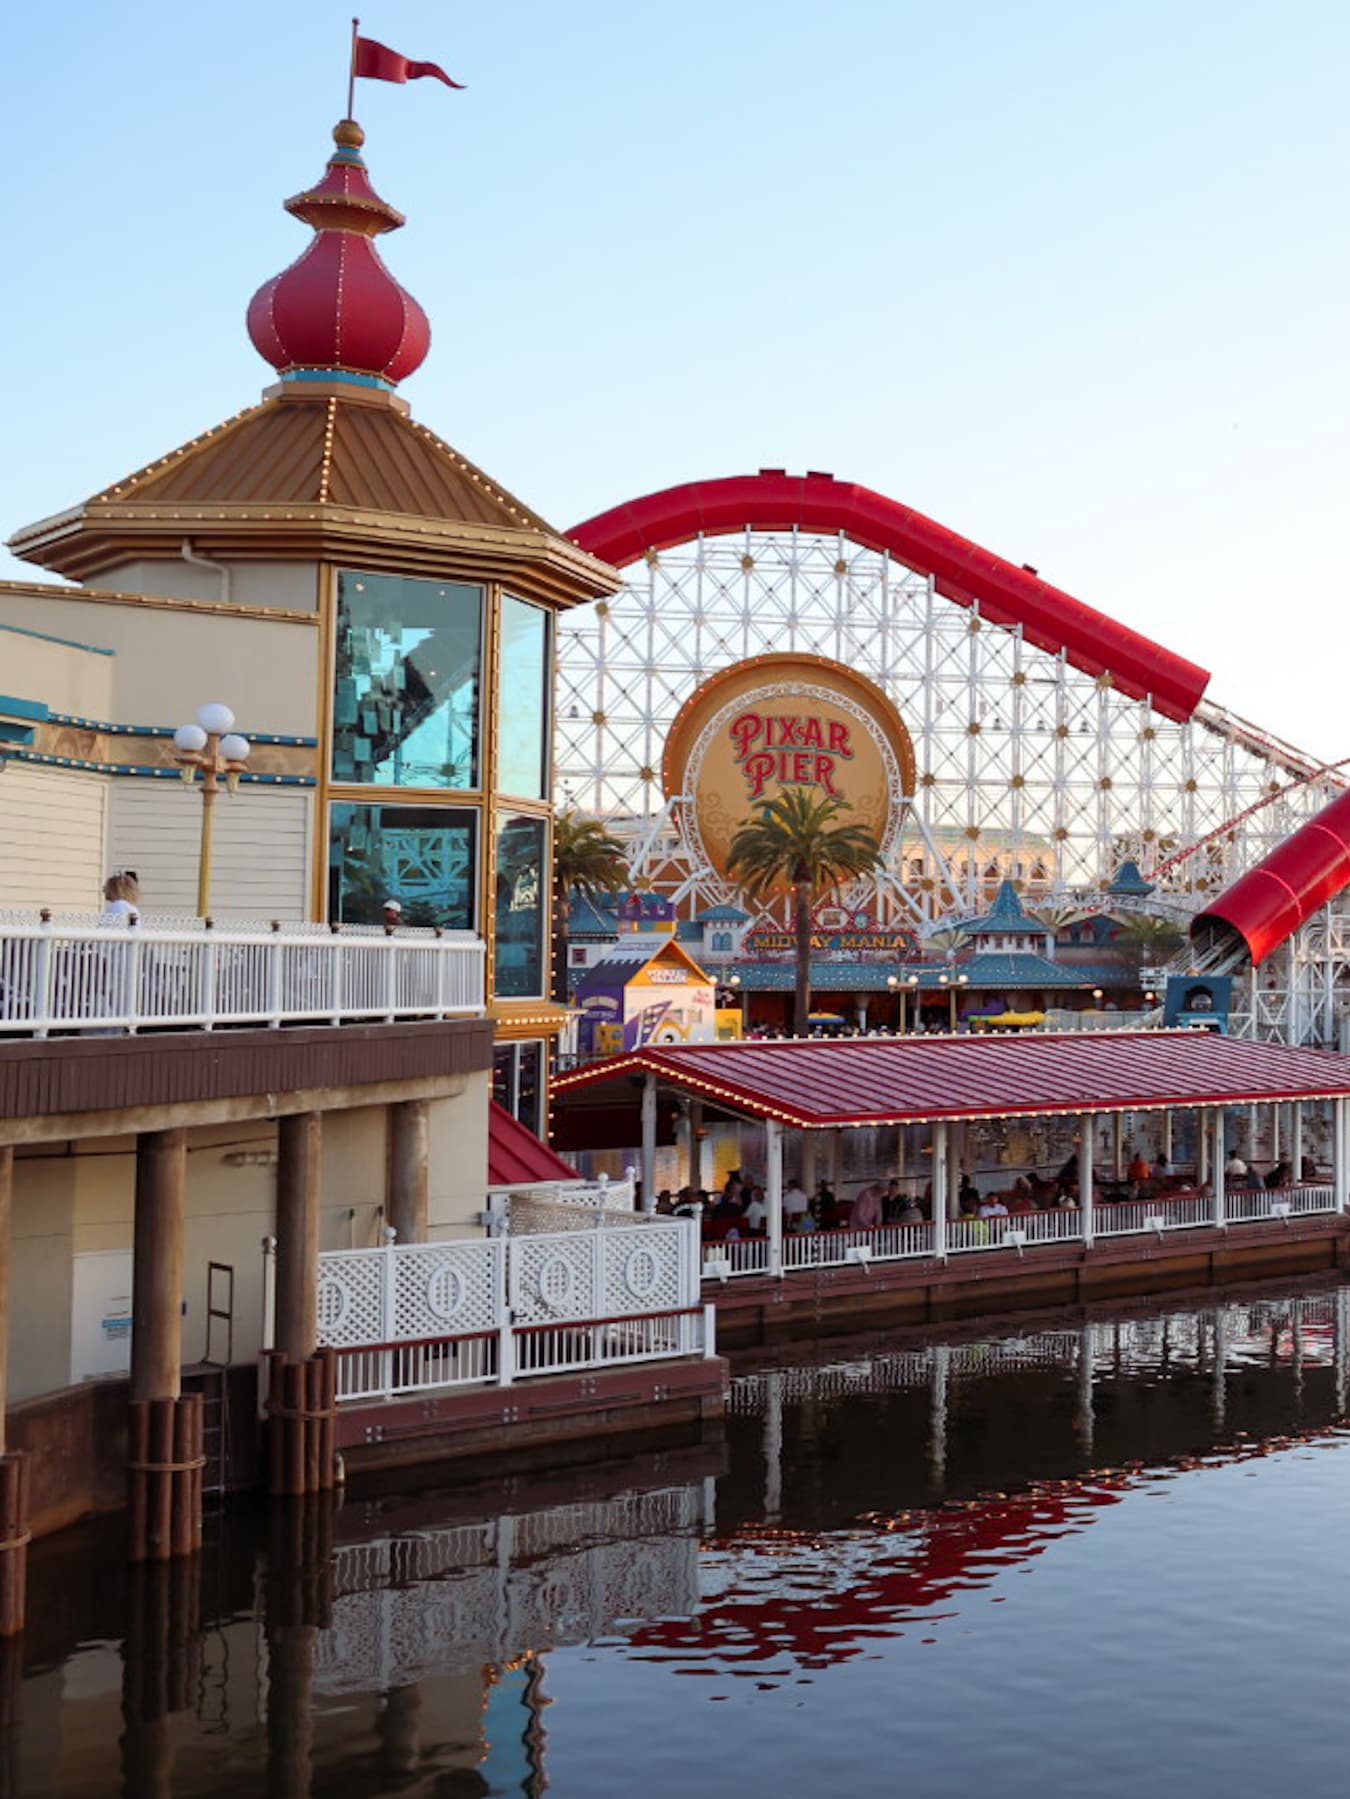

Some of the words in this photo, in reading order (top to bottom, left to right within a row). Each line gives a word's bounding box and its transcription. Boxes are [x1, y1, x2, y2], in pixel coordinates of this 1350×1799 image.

[730, 713, 854, 762] PIXAR
[744, 752, 838, 800] PIER
[753, 934, 832, 948] MIDAY
[840, 934, 906, 948] MANIA
